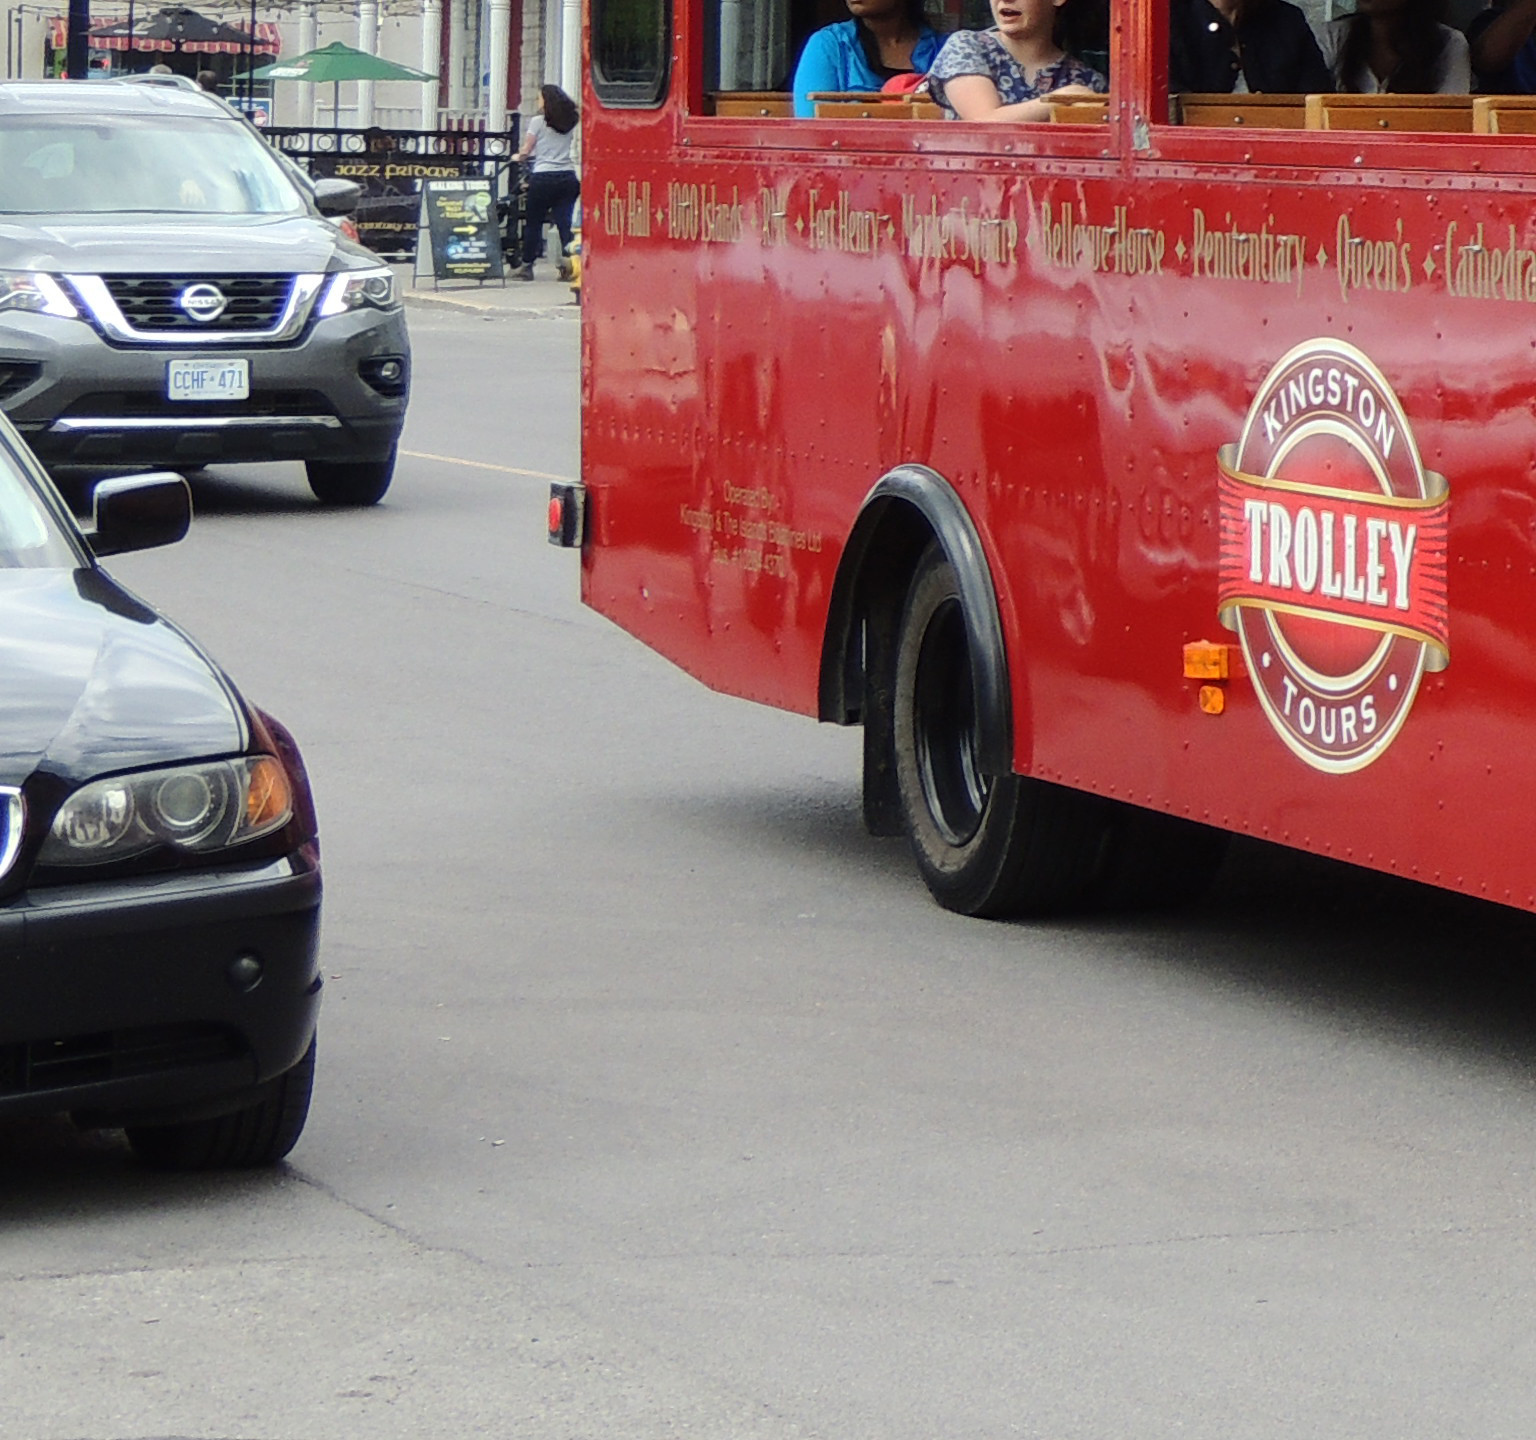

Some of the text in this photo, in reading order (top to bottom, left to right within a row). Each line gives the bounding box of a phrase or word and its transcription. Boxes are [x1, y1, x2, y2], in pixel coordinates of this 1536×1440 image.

[604, 180, 627, 248] City
[668, 182, 698, 241] 1000
[700, 184, 744, 243] Islands
[809, 189, 837, 250] Fort
[838, 190, 880, 261] Henry
[901, 193, 957, 260] Market
[960, 196, 1018, 275] Square
[1041, 201, 1111, 272] Bellevue
[1114, 205, 1165, 276] House
[1193, 207, 1306, 300] Penitentiary
[1336, 213, 1412, 304] Queen's
[174, 369, 245, 390] CCHF 471
[1261, 367, 1396, 460] KINGSTON
[1243, 498, 1418, 613] TROLLEY
[1281, 673, 1378, 745] TOURS
